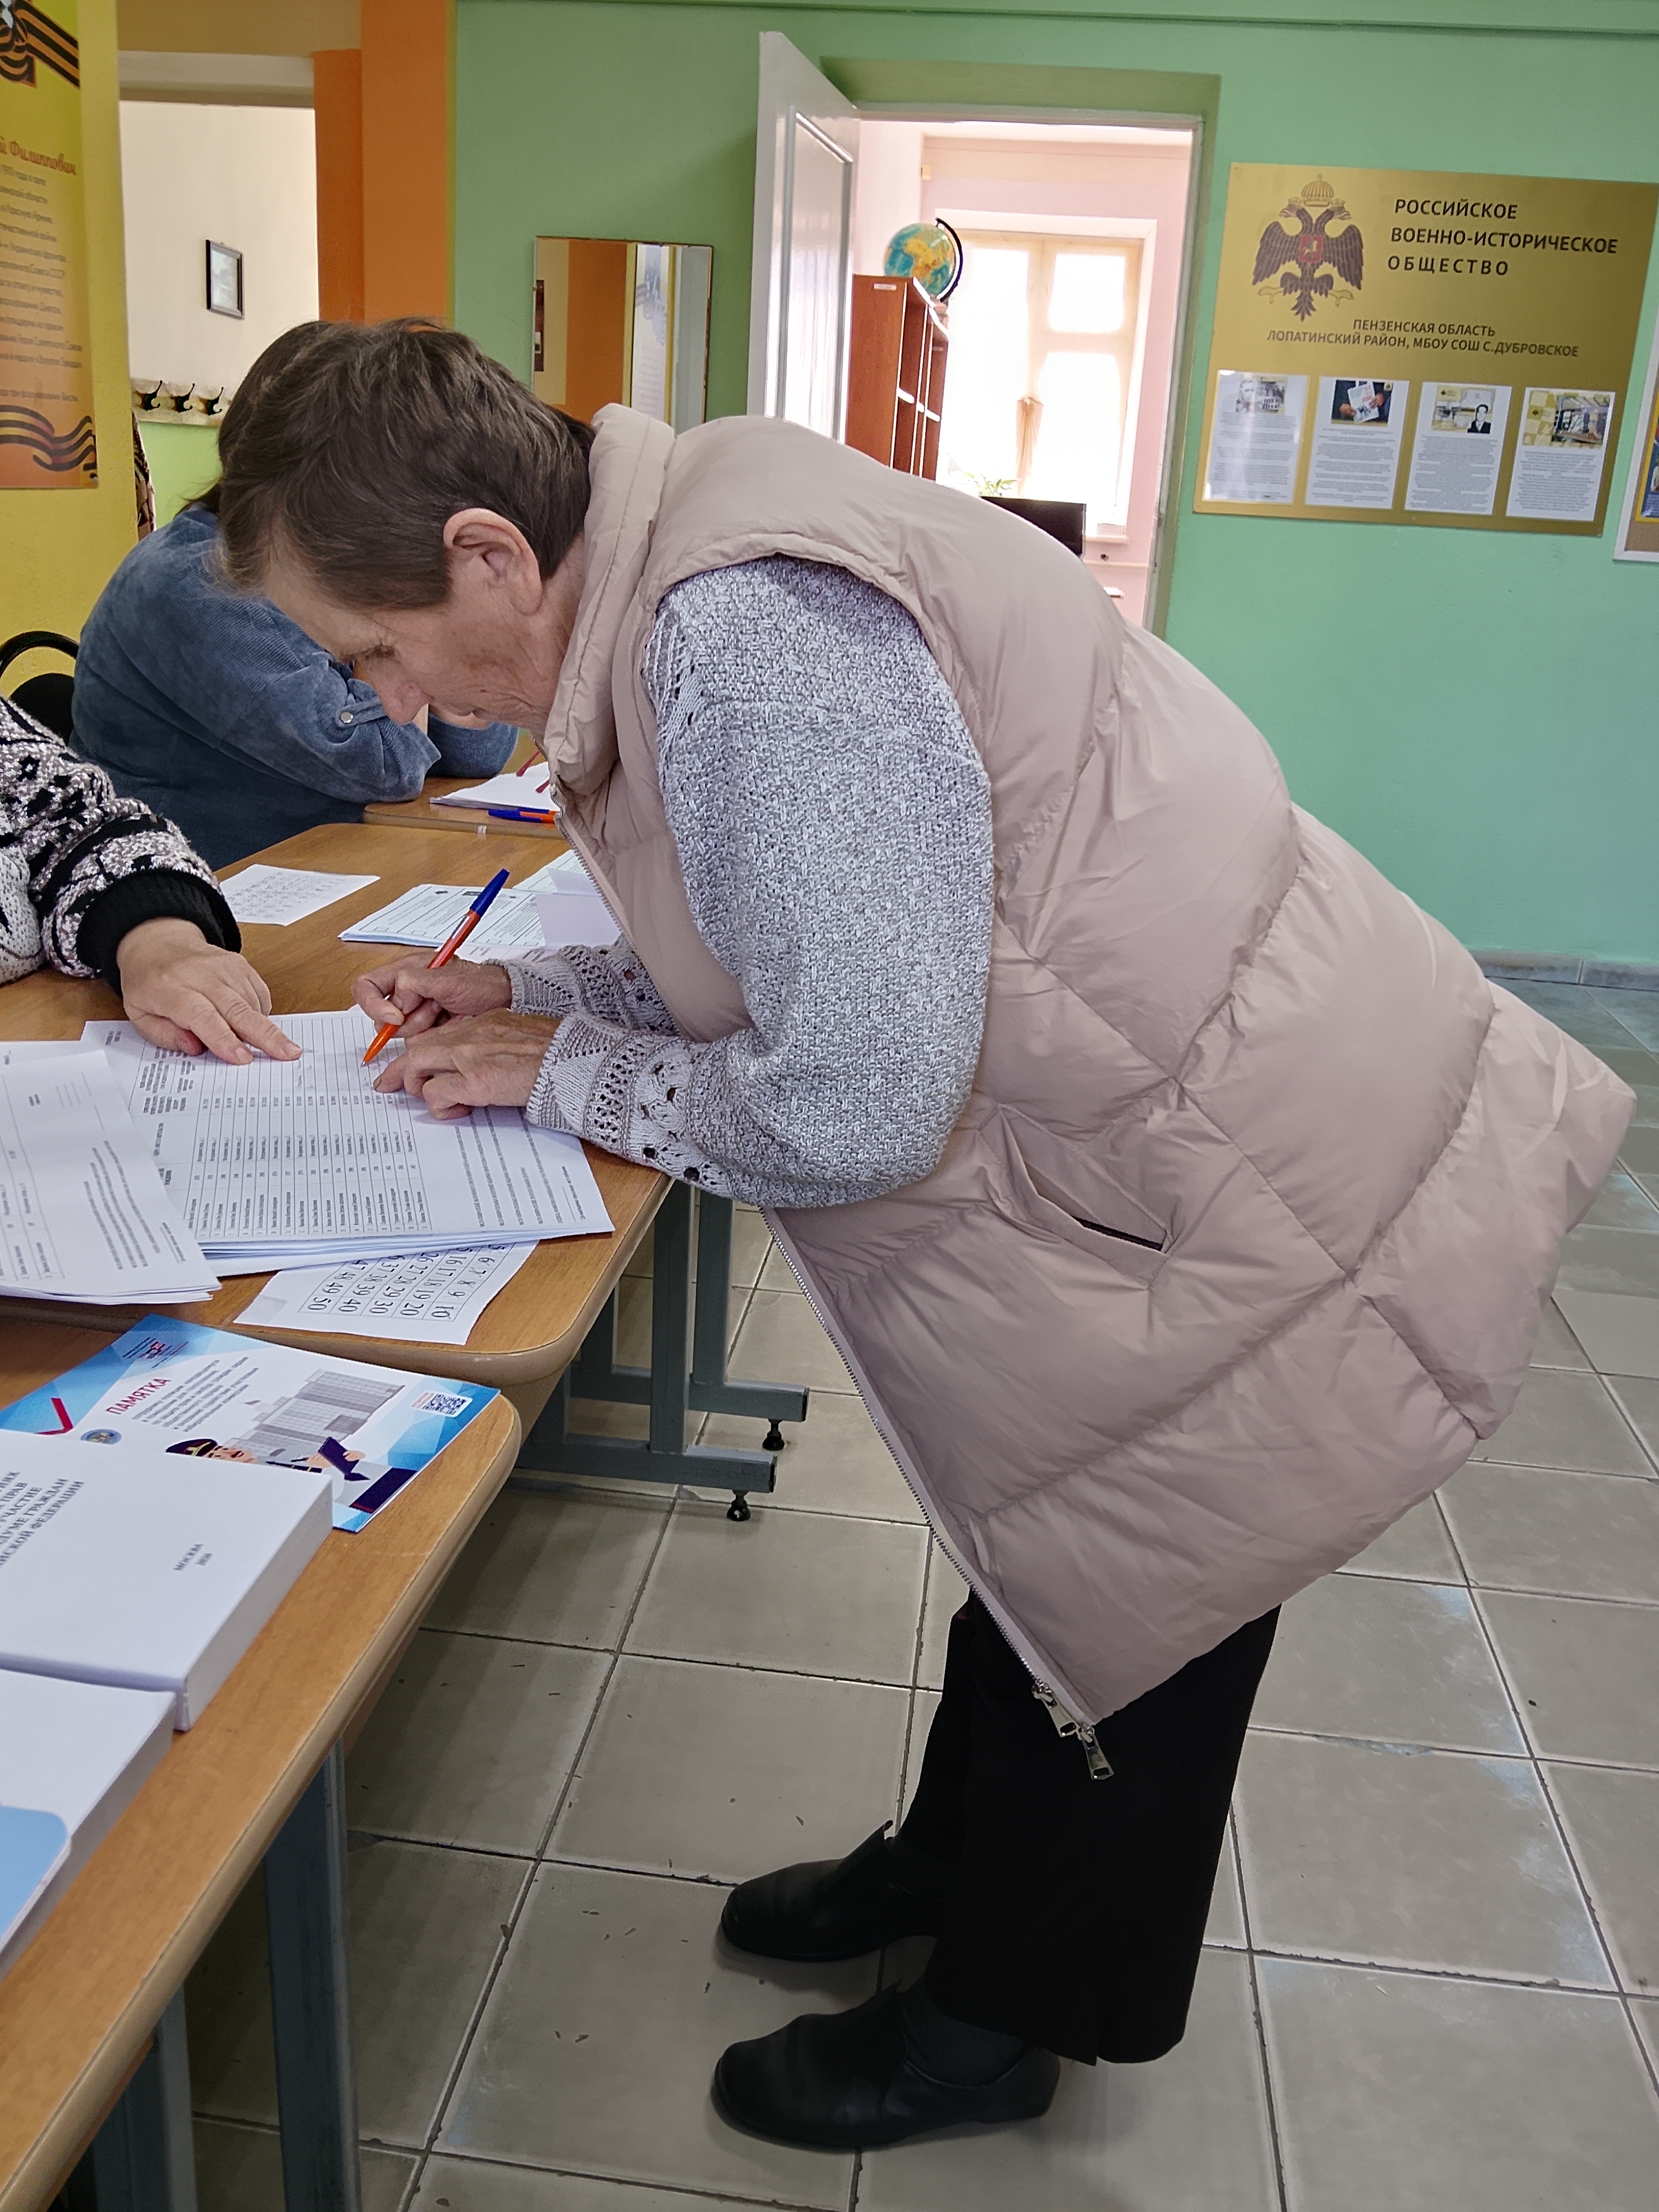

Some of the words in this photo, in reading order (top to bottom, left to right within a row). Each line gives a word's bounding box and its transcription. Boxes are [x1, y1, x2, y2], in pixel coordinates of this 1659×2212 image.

[1394, 198, 1518, 219] РОССИЙСКОЕ
[1391, 227, 1618, 253] ВОЕННО-ИСТОРИЧЕСКОЕ
[1387, 255, 1508, 275] ОБЩЕСТВО
[1353, 319, 1435, 333] ПЕНЗЕНСКАЯ
[1438, 323, 1495, 336] ОБЛАСТЬ
[1266, 329, 1360, 345] ЛОПАТИНСКИЙ
[1364, 333, 1410, 350] РАЙОН,
[1413, 337, 1448, 349] МБОУ
[1451, 339, 1480, 351] СОШ
[1483, 340, 1579, 357] С.ДУБРОВСКОЕ
[416, 1252, 439, 1263] 26
[446, 1256, 467, 1265] 16
[377, 1262, 399, 1273] 37
[406, 1264, 428, 1274] 27
[435, 1267, 456, 1277] 17
[334, 1272, 356, 1280] 48
[363, 1273, 388, 1283] 38
[393, 1276, 417, 1285] 28
[322, 1282, 344, 1294] 49
[423, 1279, 446, 1287] 18
[353, 1284, 375, 1296] 39
[383, 1286, 406, 1298] 29
[413, 1290, 434, 1300] 19
[308, 1297, 332, 1311] 50
[339, 1298, 361, 1312] 40
[369, 1300, 394, 1314] 30
[400, 1303, 424, 1316] 20
[431, 1306, 454, 1318] 10
[106, 1378, 172, 1415] ПАМЯТКА
[23, 1478, 69, 1516] ГРАЖДАН
[30, 1480, 85, 1529] ФЕДЕРАЦИИ
